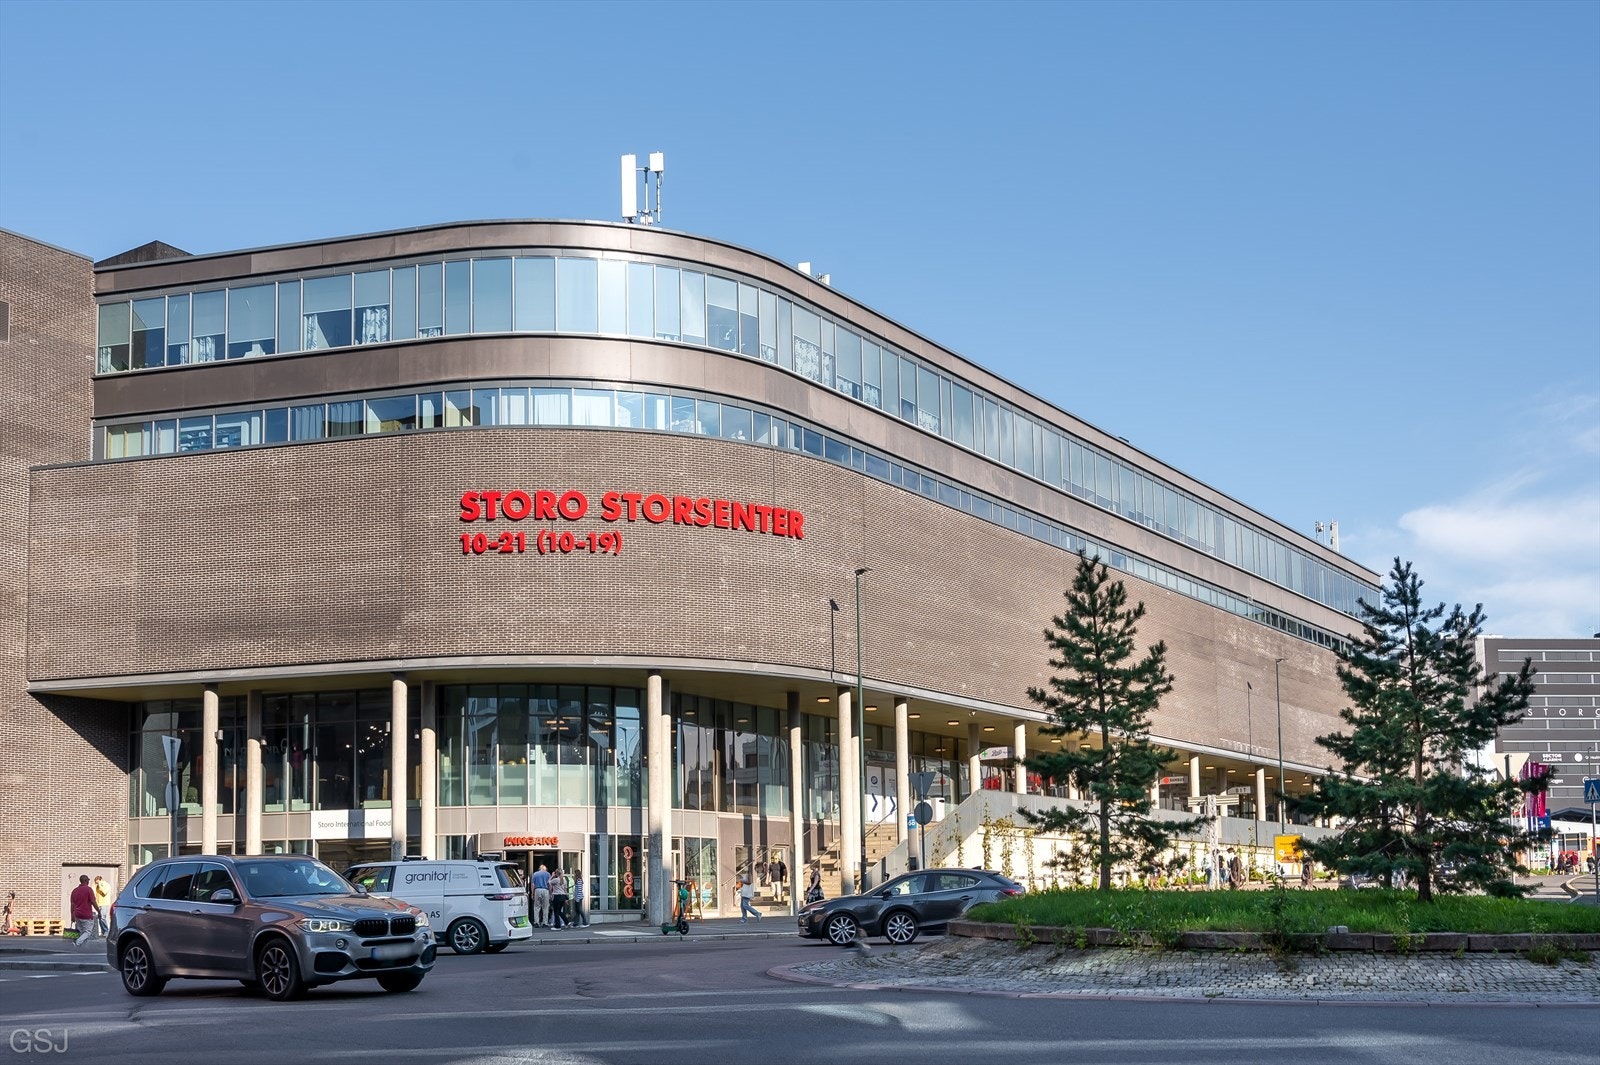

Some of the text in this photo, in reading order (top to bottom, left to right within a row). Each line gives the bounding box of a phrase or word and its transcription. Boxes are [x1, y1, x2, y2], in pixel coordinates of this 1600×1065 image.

[460, 489, 804, 539] STORO STORSENTER
[460, 529, 623, 556] 10-21 (10-19)
[317, 819, 392, 829] Storo International Food
[504, 835, 559, 848] INNGANG
[405, 870, 449, 884] granitor
[430, 910, 441, 918] AS
